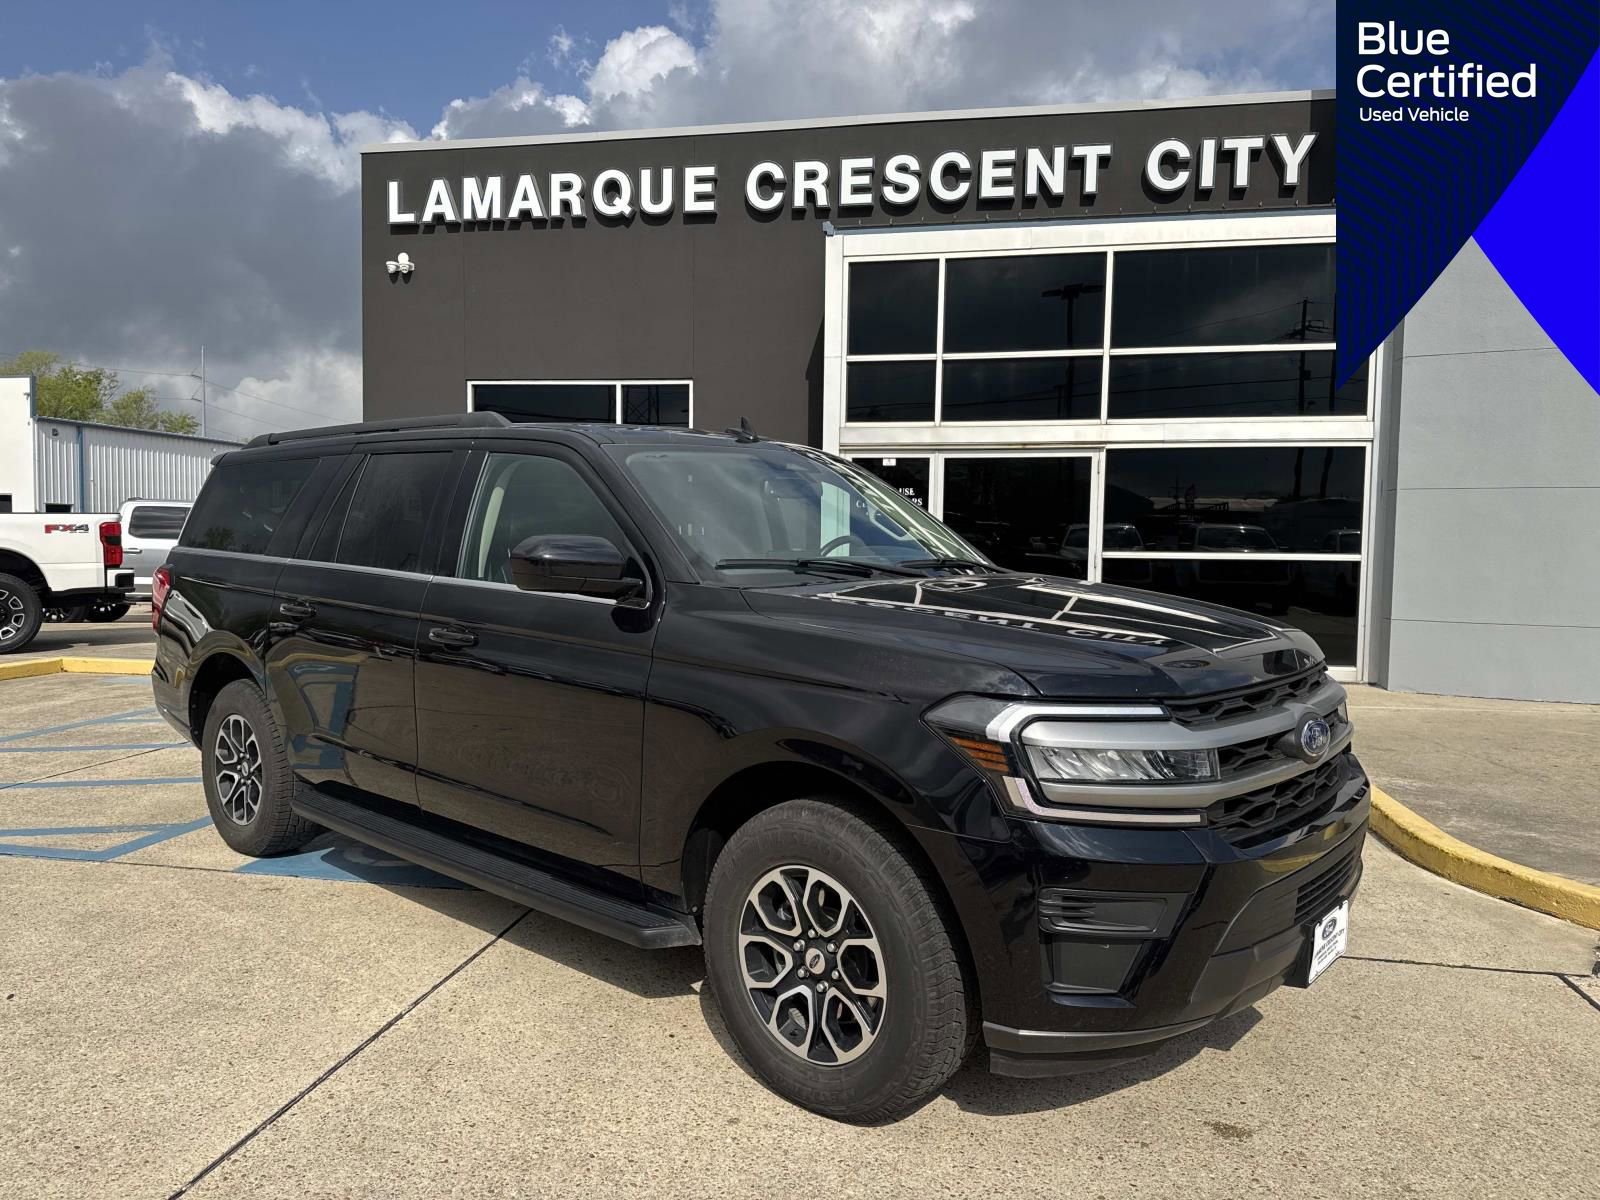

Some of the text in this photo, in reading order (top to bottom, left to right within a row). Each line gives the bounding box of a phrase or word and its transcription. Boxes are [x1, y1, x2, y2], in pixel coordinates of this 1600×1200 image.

[387, 132, 1318, 224] LAMARQUE CRESCENT CITY
[44, 523, 90, 534] FX4
